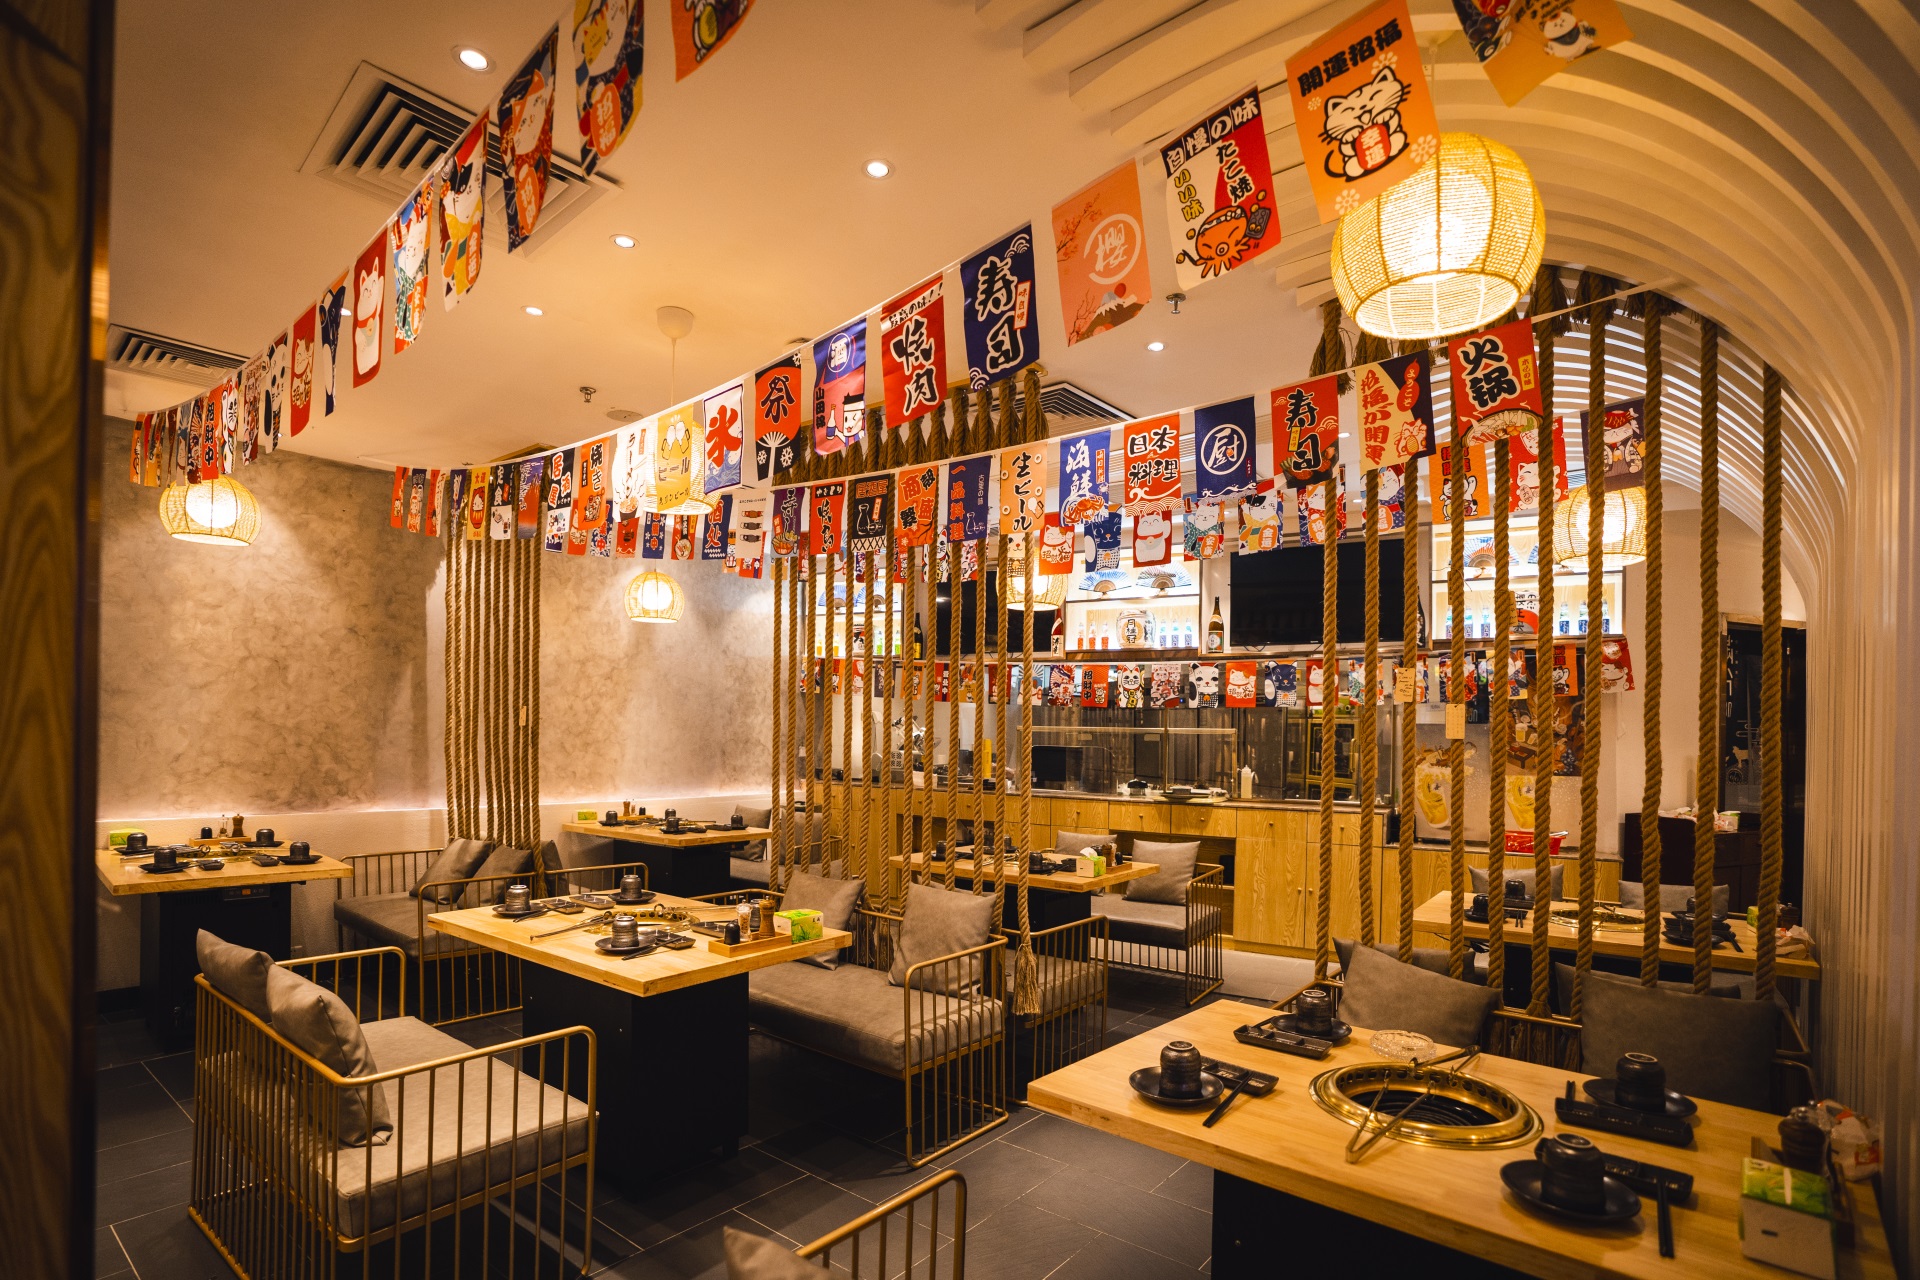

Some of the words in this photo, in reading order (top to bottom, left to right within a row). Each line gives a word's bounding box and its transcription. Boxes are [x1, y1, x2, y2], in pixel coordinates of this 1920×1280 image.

[1297, 18, 1403, 97] 開運招福
[1167, 97, 1259, 173] 自慢の味
[1361, 126, 1386, 168] 幸運
[1174, 168, 1204, 221] いい味
[975, 256, 1024, 374] 寿司
[830, 337, 848, 368] 酒
[761, 375, 796, 424] 祭
[1127, 425, 1178, 457] 日本
[1012, 451, 1033, 532] 生ビール
[1128, 458, 1178, 486] 料理
[950, 465, 967, 541] 一品料理
